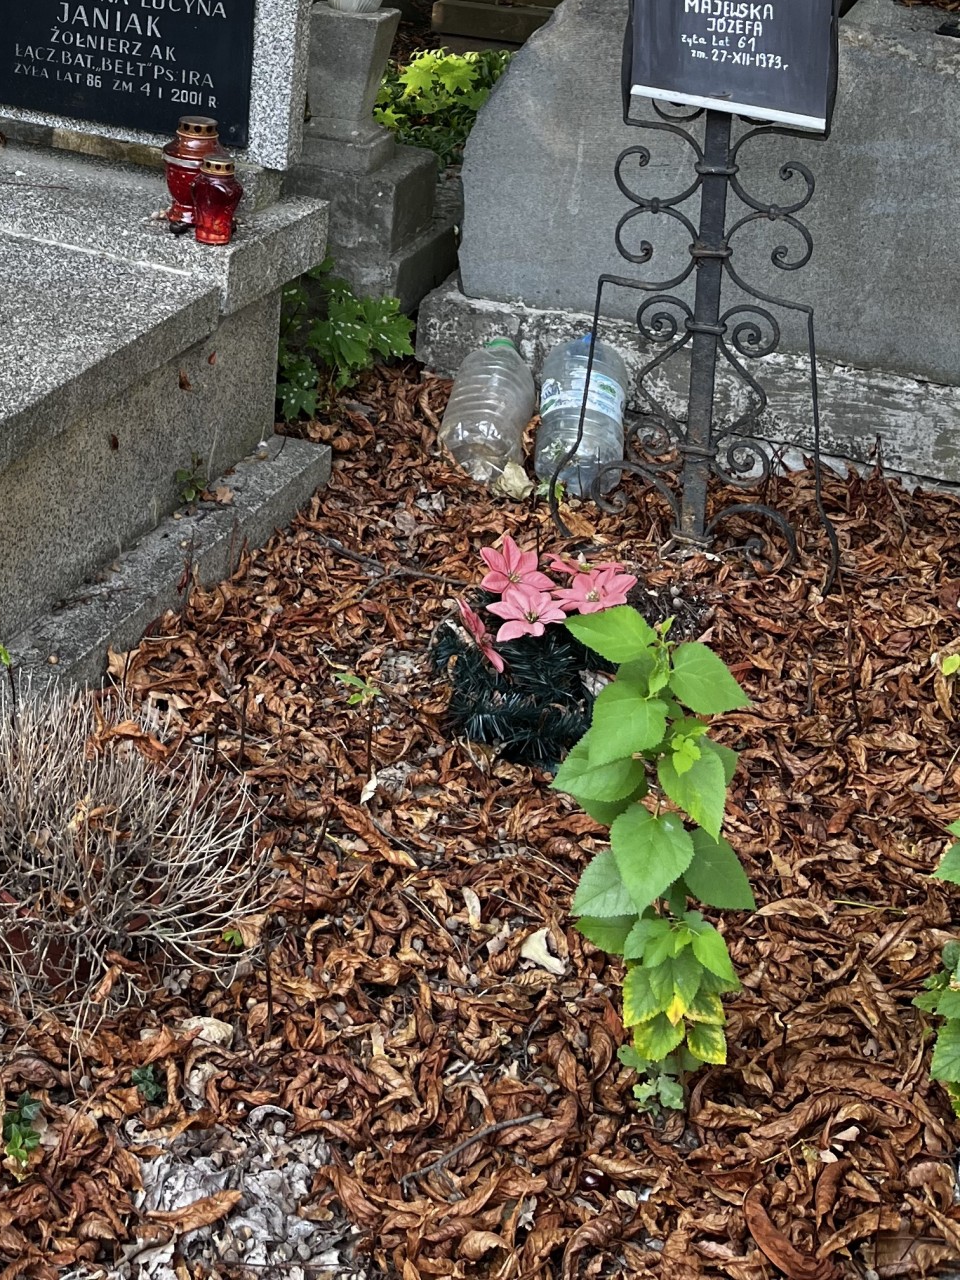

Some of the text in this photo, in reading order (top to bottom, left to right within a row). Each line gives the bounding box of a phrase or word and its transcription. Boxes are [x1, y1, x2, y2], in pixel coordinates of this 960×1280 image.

[56, 1, 162, 38] JANIAK
[706, 16, 763, 37] JÓZEFA
[50, 25, 177, 62] ŻOŁNIERZ AK
[737, 35, 756, 52] 61
[56, 70, 82, 84] LAT
[86, 73, 102, 88] 86
[140, 82, 151, 97] 4
[171, 88, 202, 106] 2001
[182, 69, 214, 89] IRA
